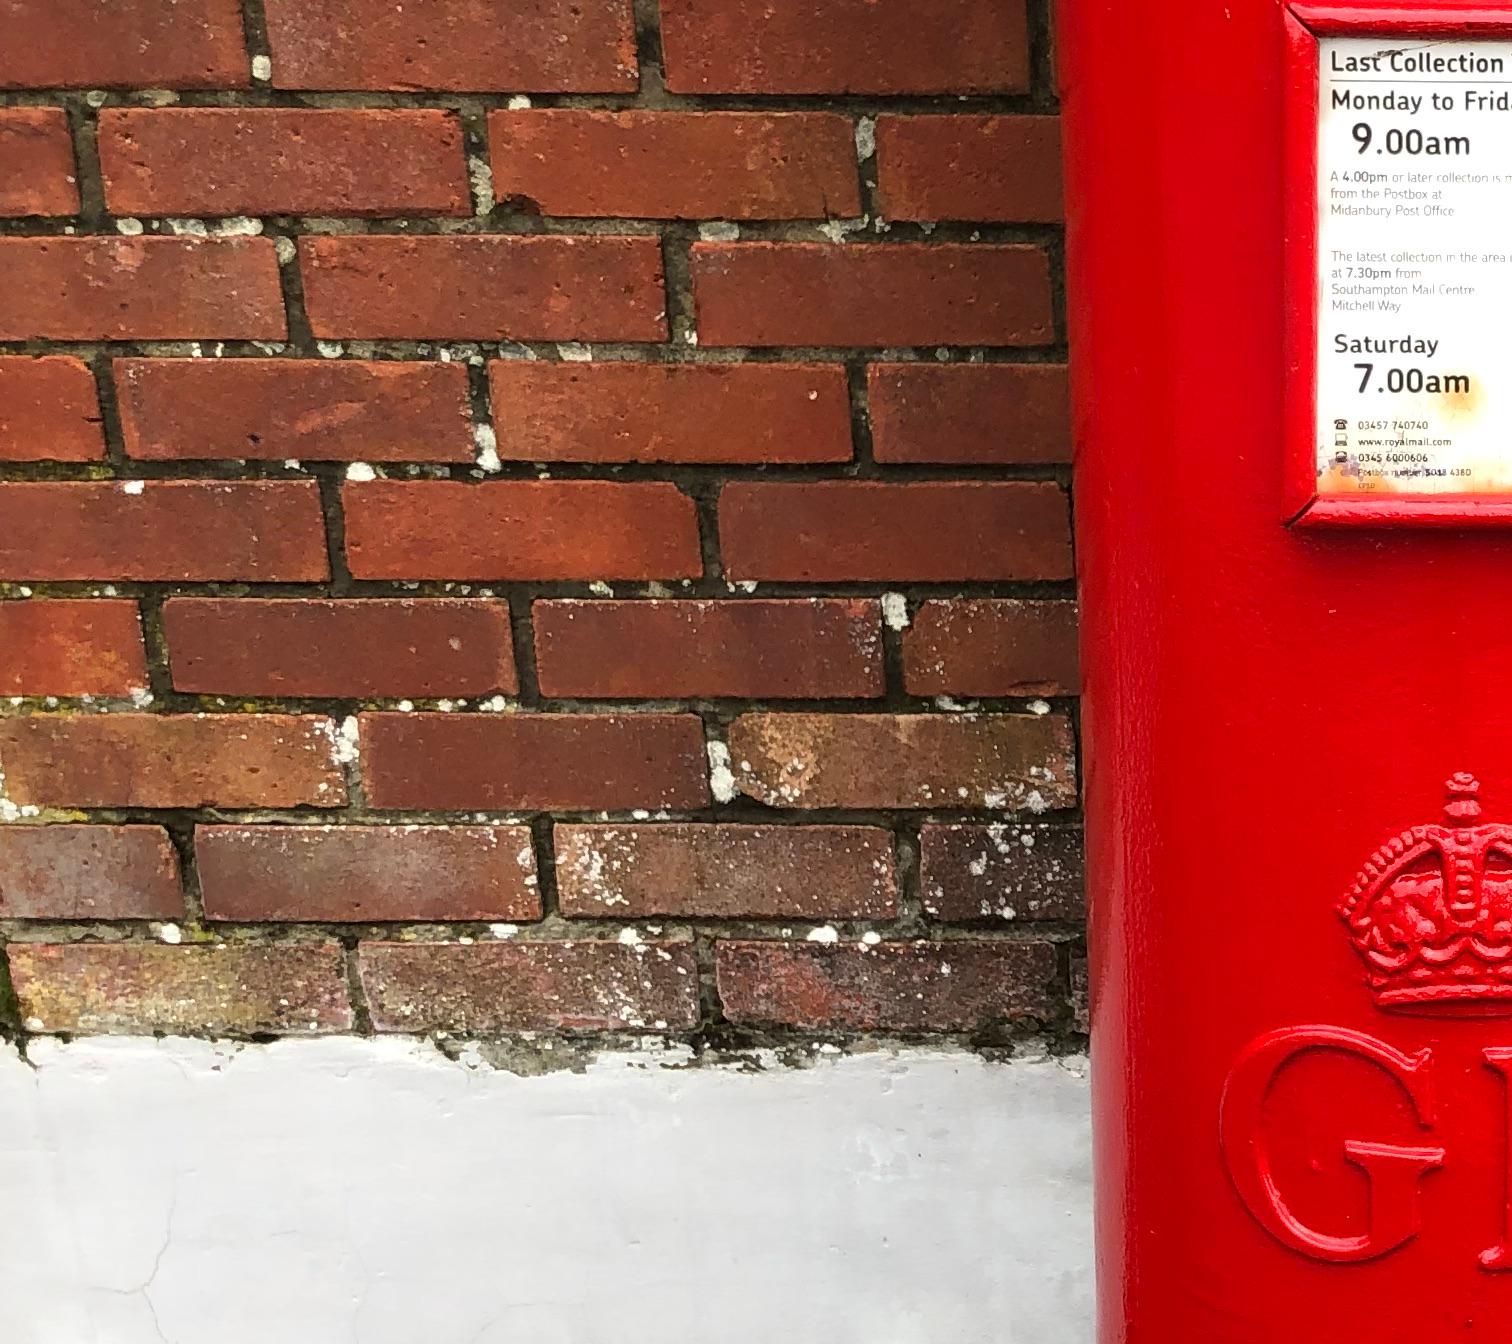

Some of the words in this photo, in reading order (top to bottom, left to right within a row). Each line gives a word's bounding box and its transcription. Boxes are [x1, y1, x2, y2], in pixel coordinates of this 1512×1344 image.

[1331, 50, 1381, 73] Last
[1390, 51, 1503, 73] Collection
[1331, 90, 1422, 115] Monday
[1432, 93, 1454, 111] to
[1352, 122, 1471, 155] 9.00am
[1330, 171, 1338, 182] A
[1342, 171, 1388, 185] 4.00pm
[1392, 174, 1405, 183] or
[1407, 172, 1432, 183] later
[1437, 172, 1489, 183] collection
[1493, 173, 1501, 183] is
[1330, 188, 1358, 199] from
[1361, 189, 1380, 199] the
[1384, 189, 1428, 200] Postbox
[1432, 190, 1442, 200] at
[1331, 205, 1391, 217] Midanbury
[1395, 205, 1420, 216] Post
[1423, 205, 1455, 217] Office
[1331, 250, 1353, 262] The
[1356, 251, 1387, 263] latest
[1390, 252, 1443, 263] collection
[1446, 253, 1455, 263] in
[1460, 252, 1478, 263] the
[1482, 254, 1506, 263] area
[1331, 268, 1342, 278] at
[1346, 267, 1392, 281] 7.30pm
[1395, 268, 1422, 279] from
[1331, 283, 1408, 297] Southampton
[1412, 284, 1435, 295] Mail
[1332, 300, 1375, 311] Mitchell
[1378, 300, 1401, 313] Way
[1334, 334, 1439, 358] Saturday
[1353, 363, 1471, 394] 7.00am
[1358, 420, 1388, 430] 03457
[1391, 420, 1429, 430] 740740
[1358, 437, 1452, 447] www.royalmail.com
[1358, 453, 1382, 463] 0345
[1386, 453, 1429, 463] 6000606
